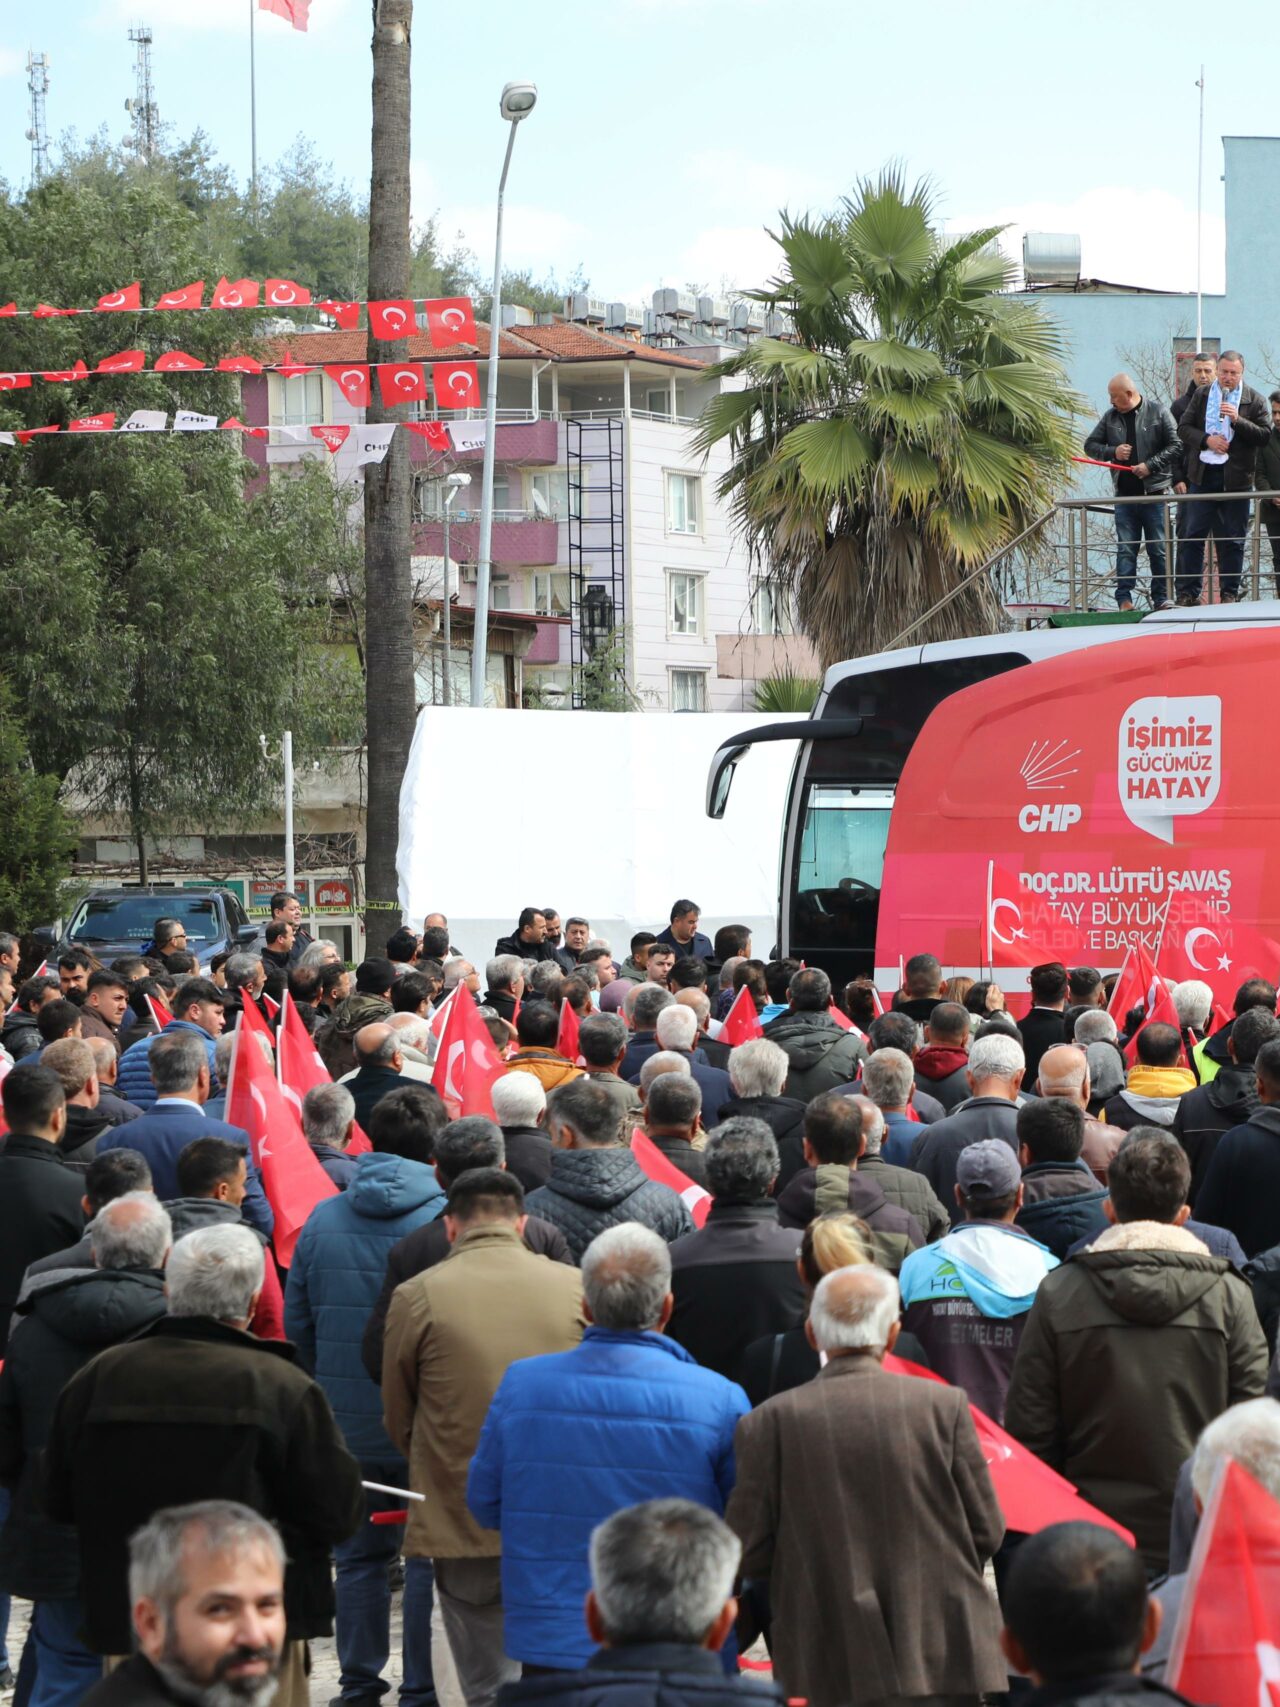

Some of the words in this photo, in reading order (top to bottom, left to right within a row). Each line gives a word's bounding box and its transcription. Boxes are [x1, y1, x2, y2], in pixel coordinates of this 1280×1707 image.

[1126, 752, 1212, 772] GÜCÜMÜZ
[1127, 776, 1212, 799] HATAY
[1018, 804, 1082, 833] CHP
[1099, 866, 1163, 893] LÜTFÜ
[1167, 869, 1232, 897] SAVAŞ
[1021, 902, 1085, 925] HATAY
